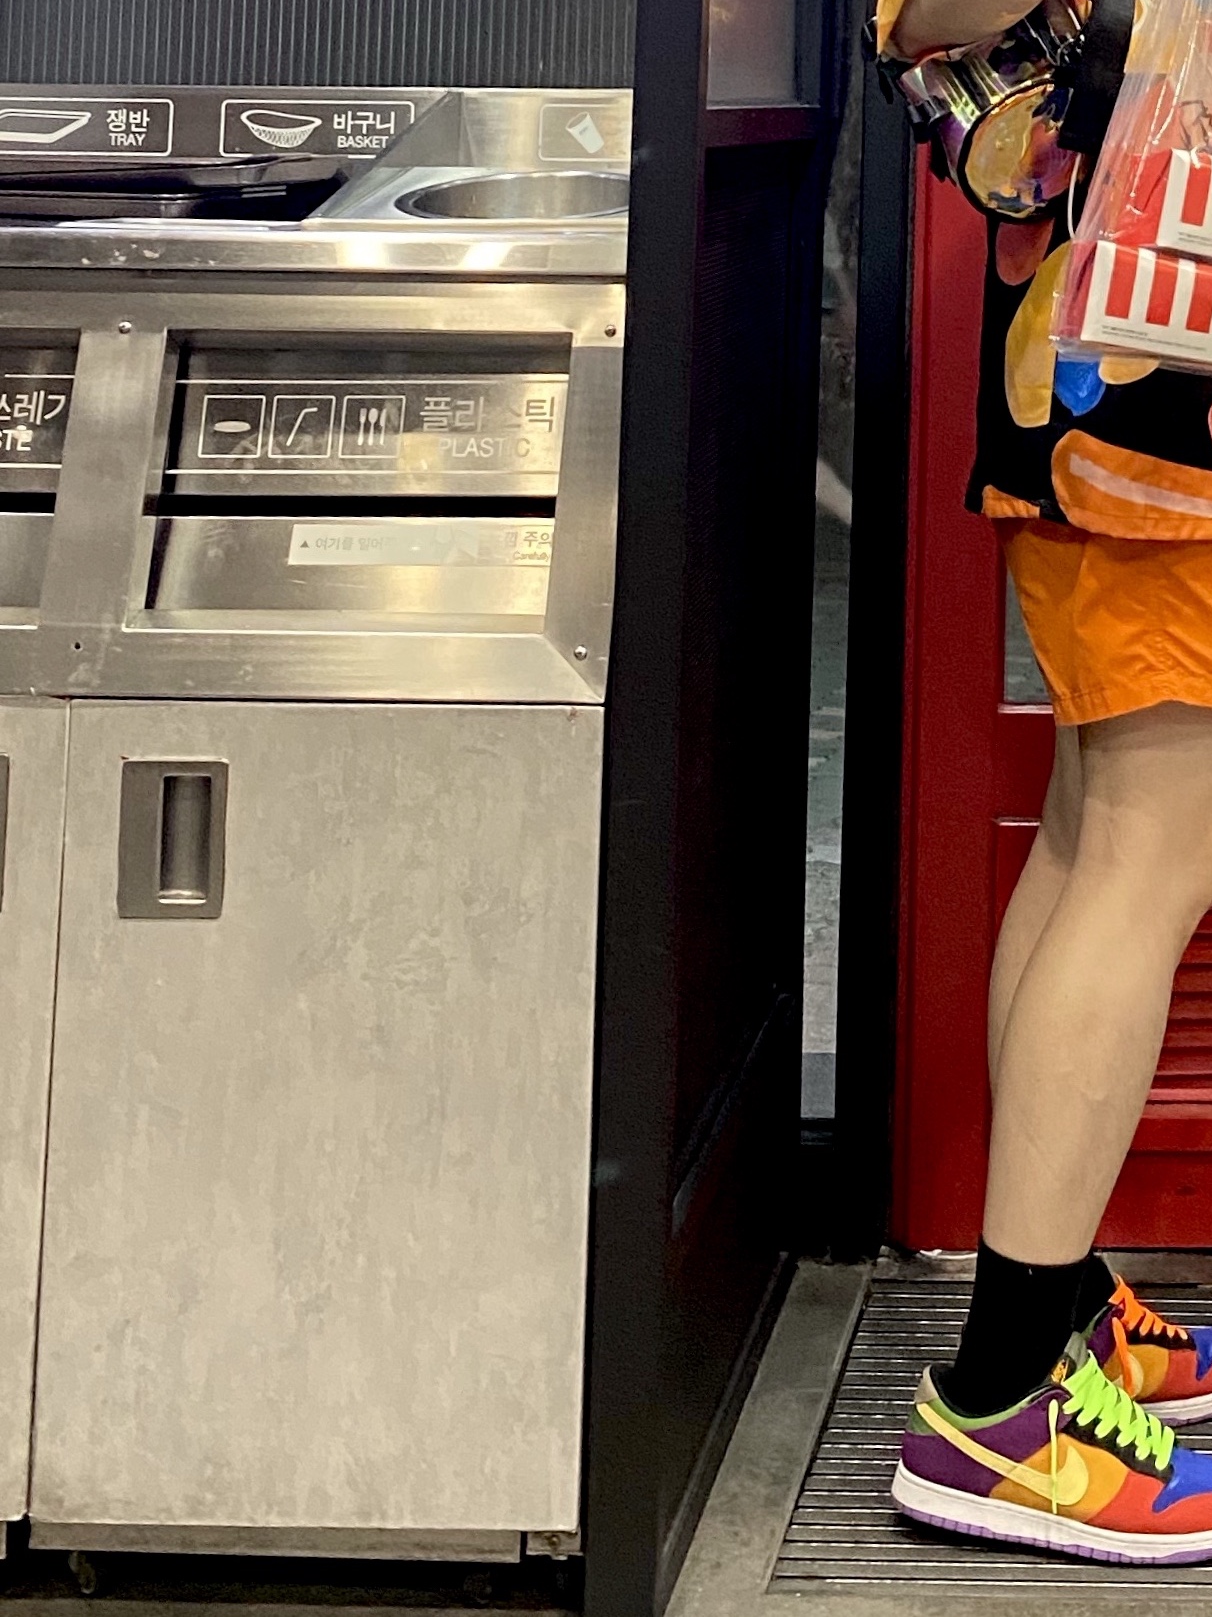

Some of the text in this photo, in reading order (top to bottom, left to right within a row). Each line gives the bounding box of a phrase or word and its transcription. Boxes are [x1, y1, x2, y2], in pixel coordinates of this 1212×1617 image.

[105, 107, 151, 134] 쟁반
[332, 109, 397, 136] 바구니
[108, 133, 146, 147] TRAY
[336, 134, 389, 149] BASKET
[0, 425, 34, 451] TE
[439, 436, 532, 458] PLASTC
